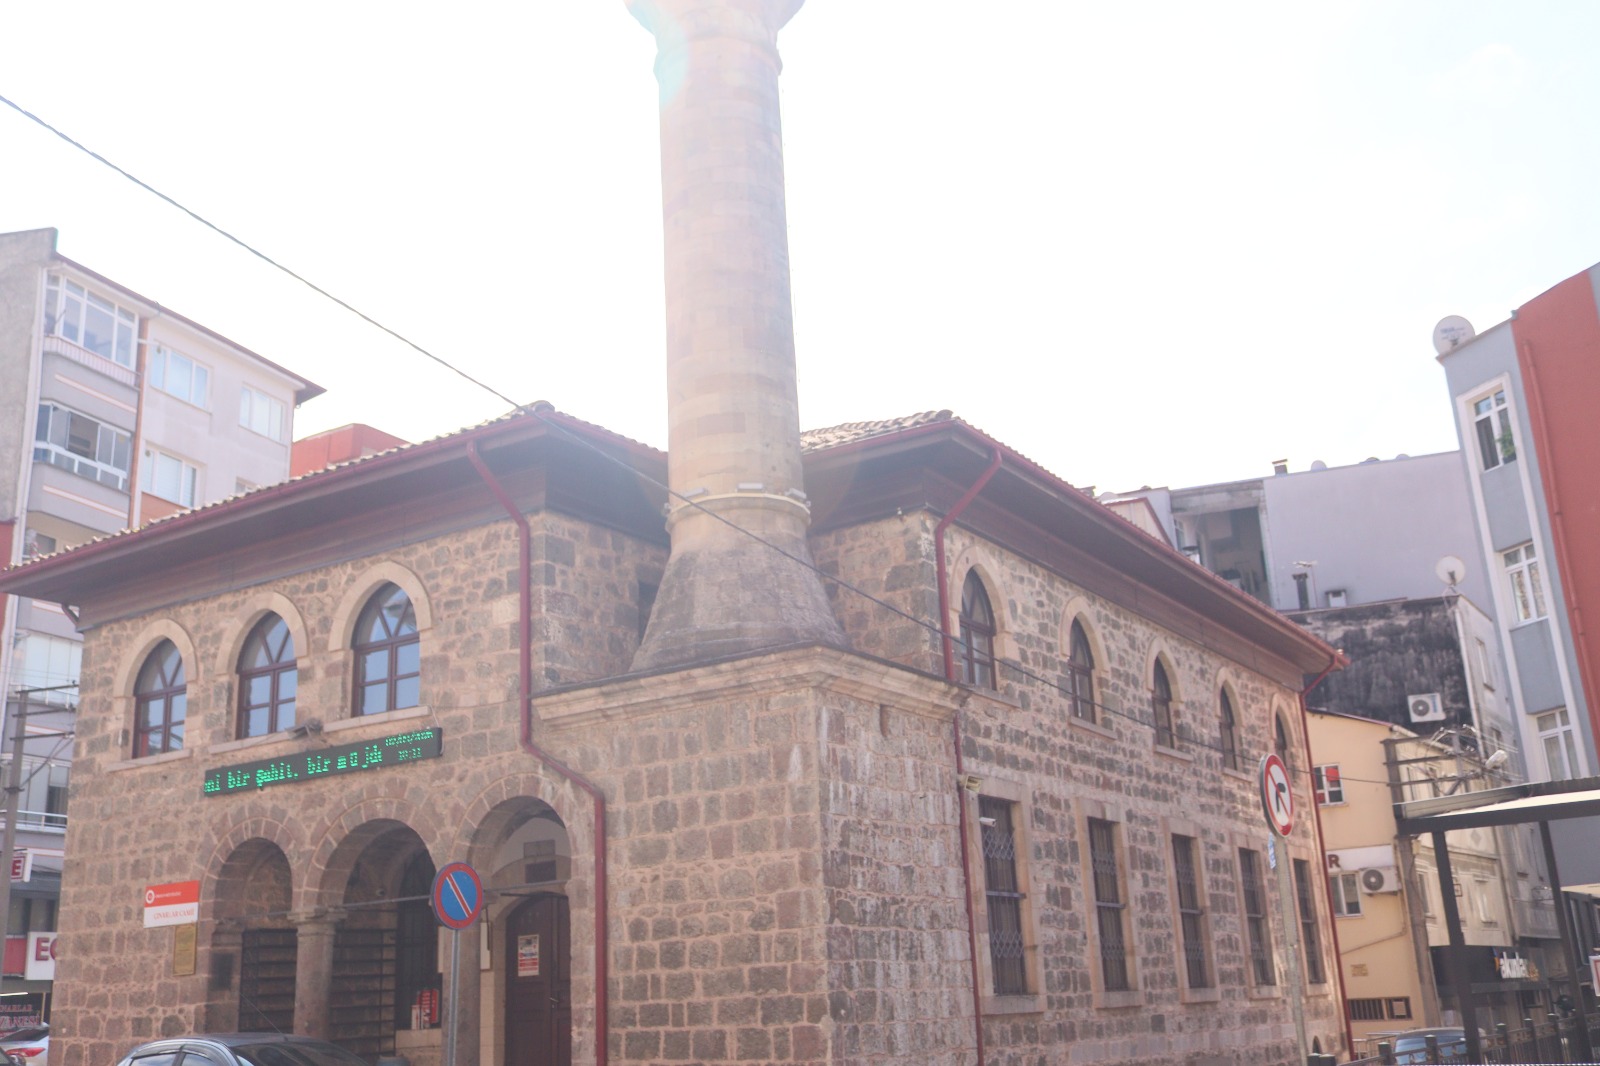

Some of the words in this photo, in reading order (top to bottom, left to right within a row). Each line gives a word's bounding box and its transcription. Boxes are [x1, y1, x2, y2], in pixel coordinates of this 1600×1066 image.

[227, 769, 251, 789] bir
[306, 755, 331, 775] bir
[11, 859, 22, 876] E
[1328, 854, 1341, 868] R
